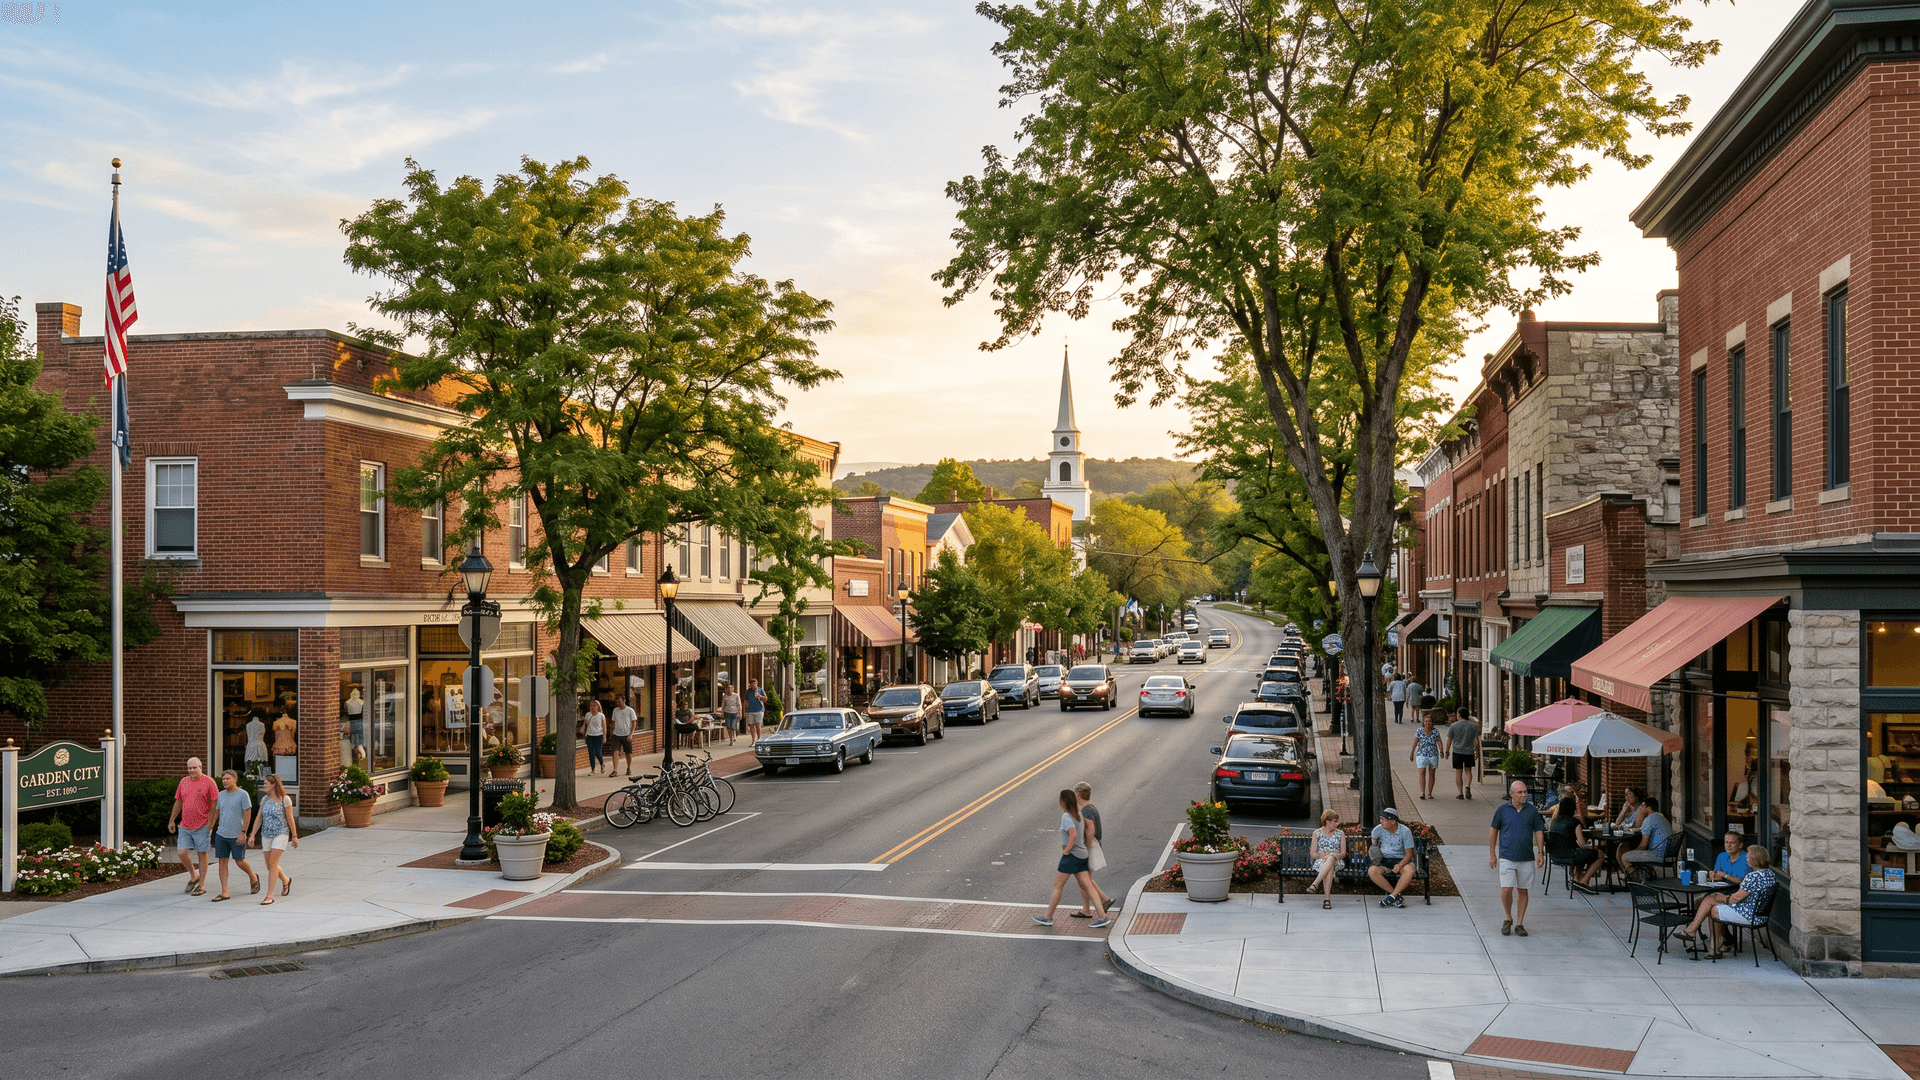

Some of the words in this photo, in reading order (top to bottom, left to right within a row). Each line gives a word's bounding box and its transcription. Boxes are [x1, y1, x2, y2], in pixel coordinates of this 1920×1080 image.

[20, 769, 71, 788] GARDEN
[73, 766, 101, 781] CITY
[46, 789, 62, 798] EST.
[62, 786, 78, 796] 1890
